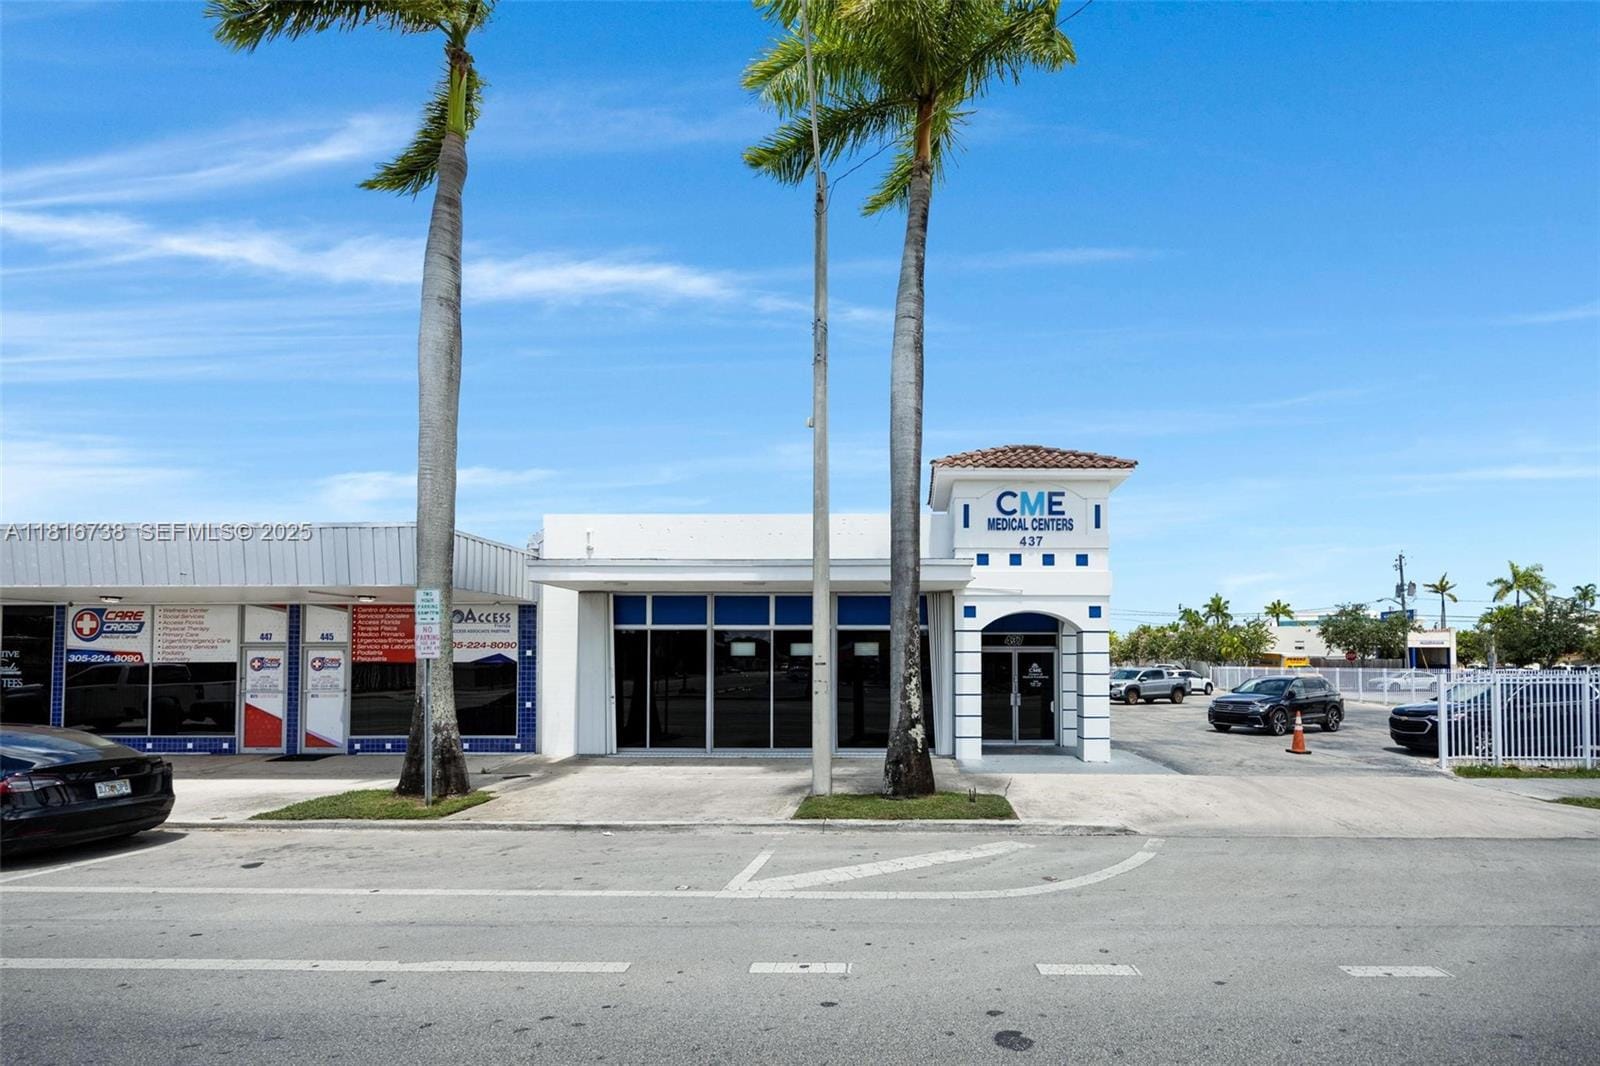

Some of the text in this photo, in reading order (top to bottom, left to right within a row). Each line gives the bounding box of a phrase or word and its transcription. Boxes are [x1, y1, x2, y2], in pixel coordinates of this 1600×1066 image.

[996, 491, 1065, 516] CME
[987, 518, 1074, 531] MEDICAL CENTERS
[1019, 536, 1043, 547] 437
[104, 611, 145, 620] CARE
[103, 623, 140, 631] CROSS
[260, 633, 272, 641] 447
[320, 633, 334, 641] 445
[451, 641, 517, 649] 05-224-8090
[68, 654, 141, 663] 305-224-8090
